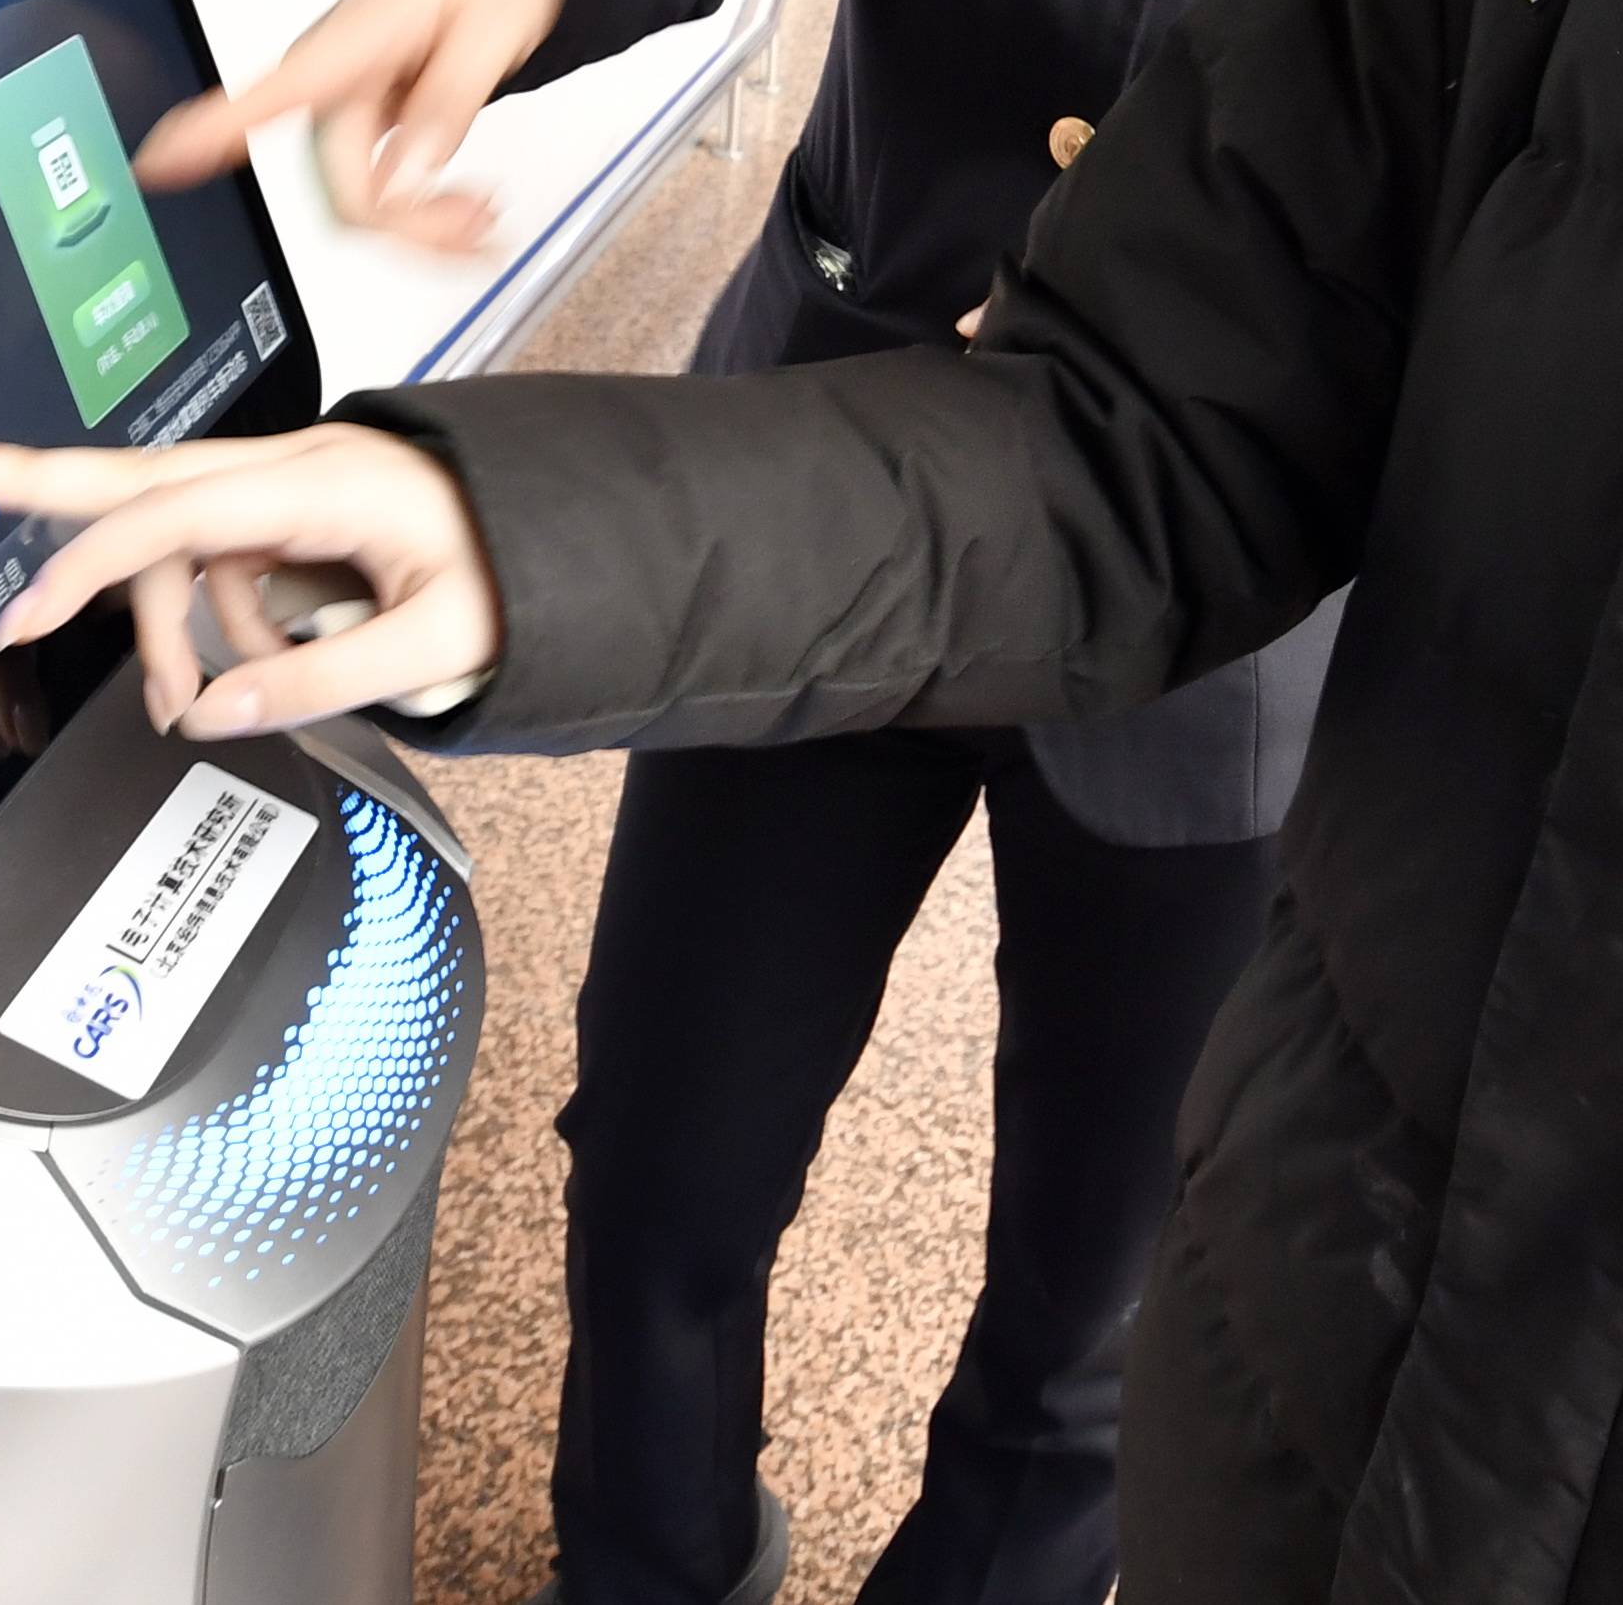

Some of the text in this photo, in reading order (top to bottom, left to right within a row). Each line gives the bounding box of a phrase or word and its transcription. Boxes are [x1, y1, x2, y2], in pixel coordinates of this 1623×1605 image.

[121, 790, 246, 948] 电子计算技术研究所
[73, 993, 129, 1059] CARS
